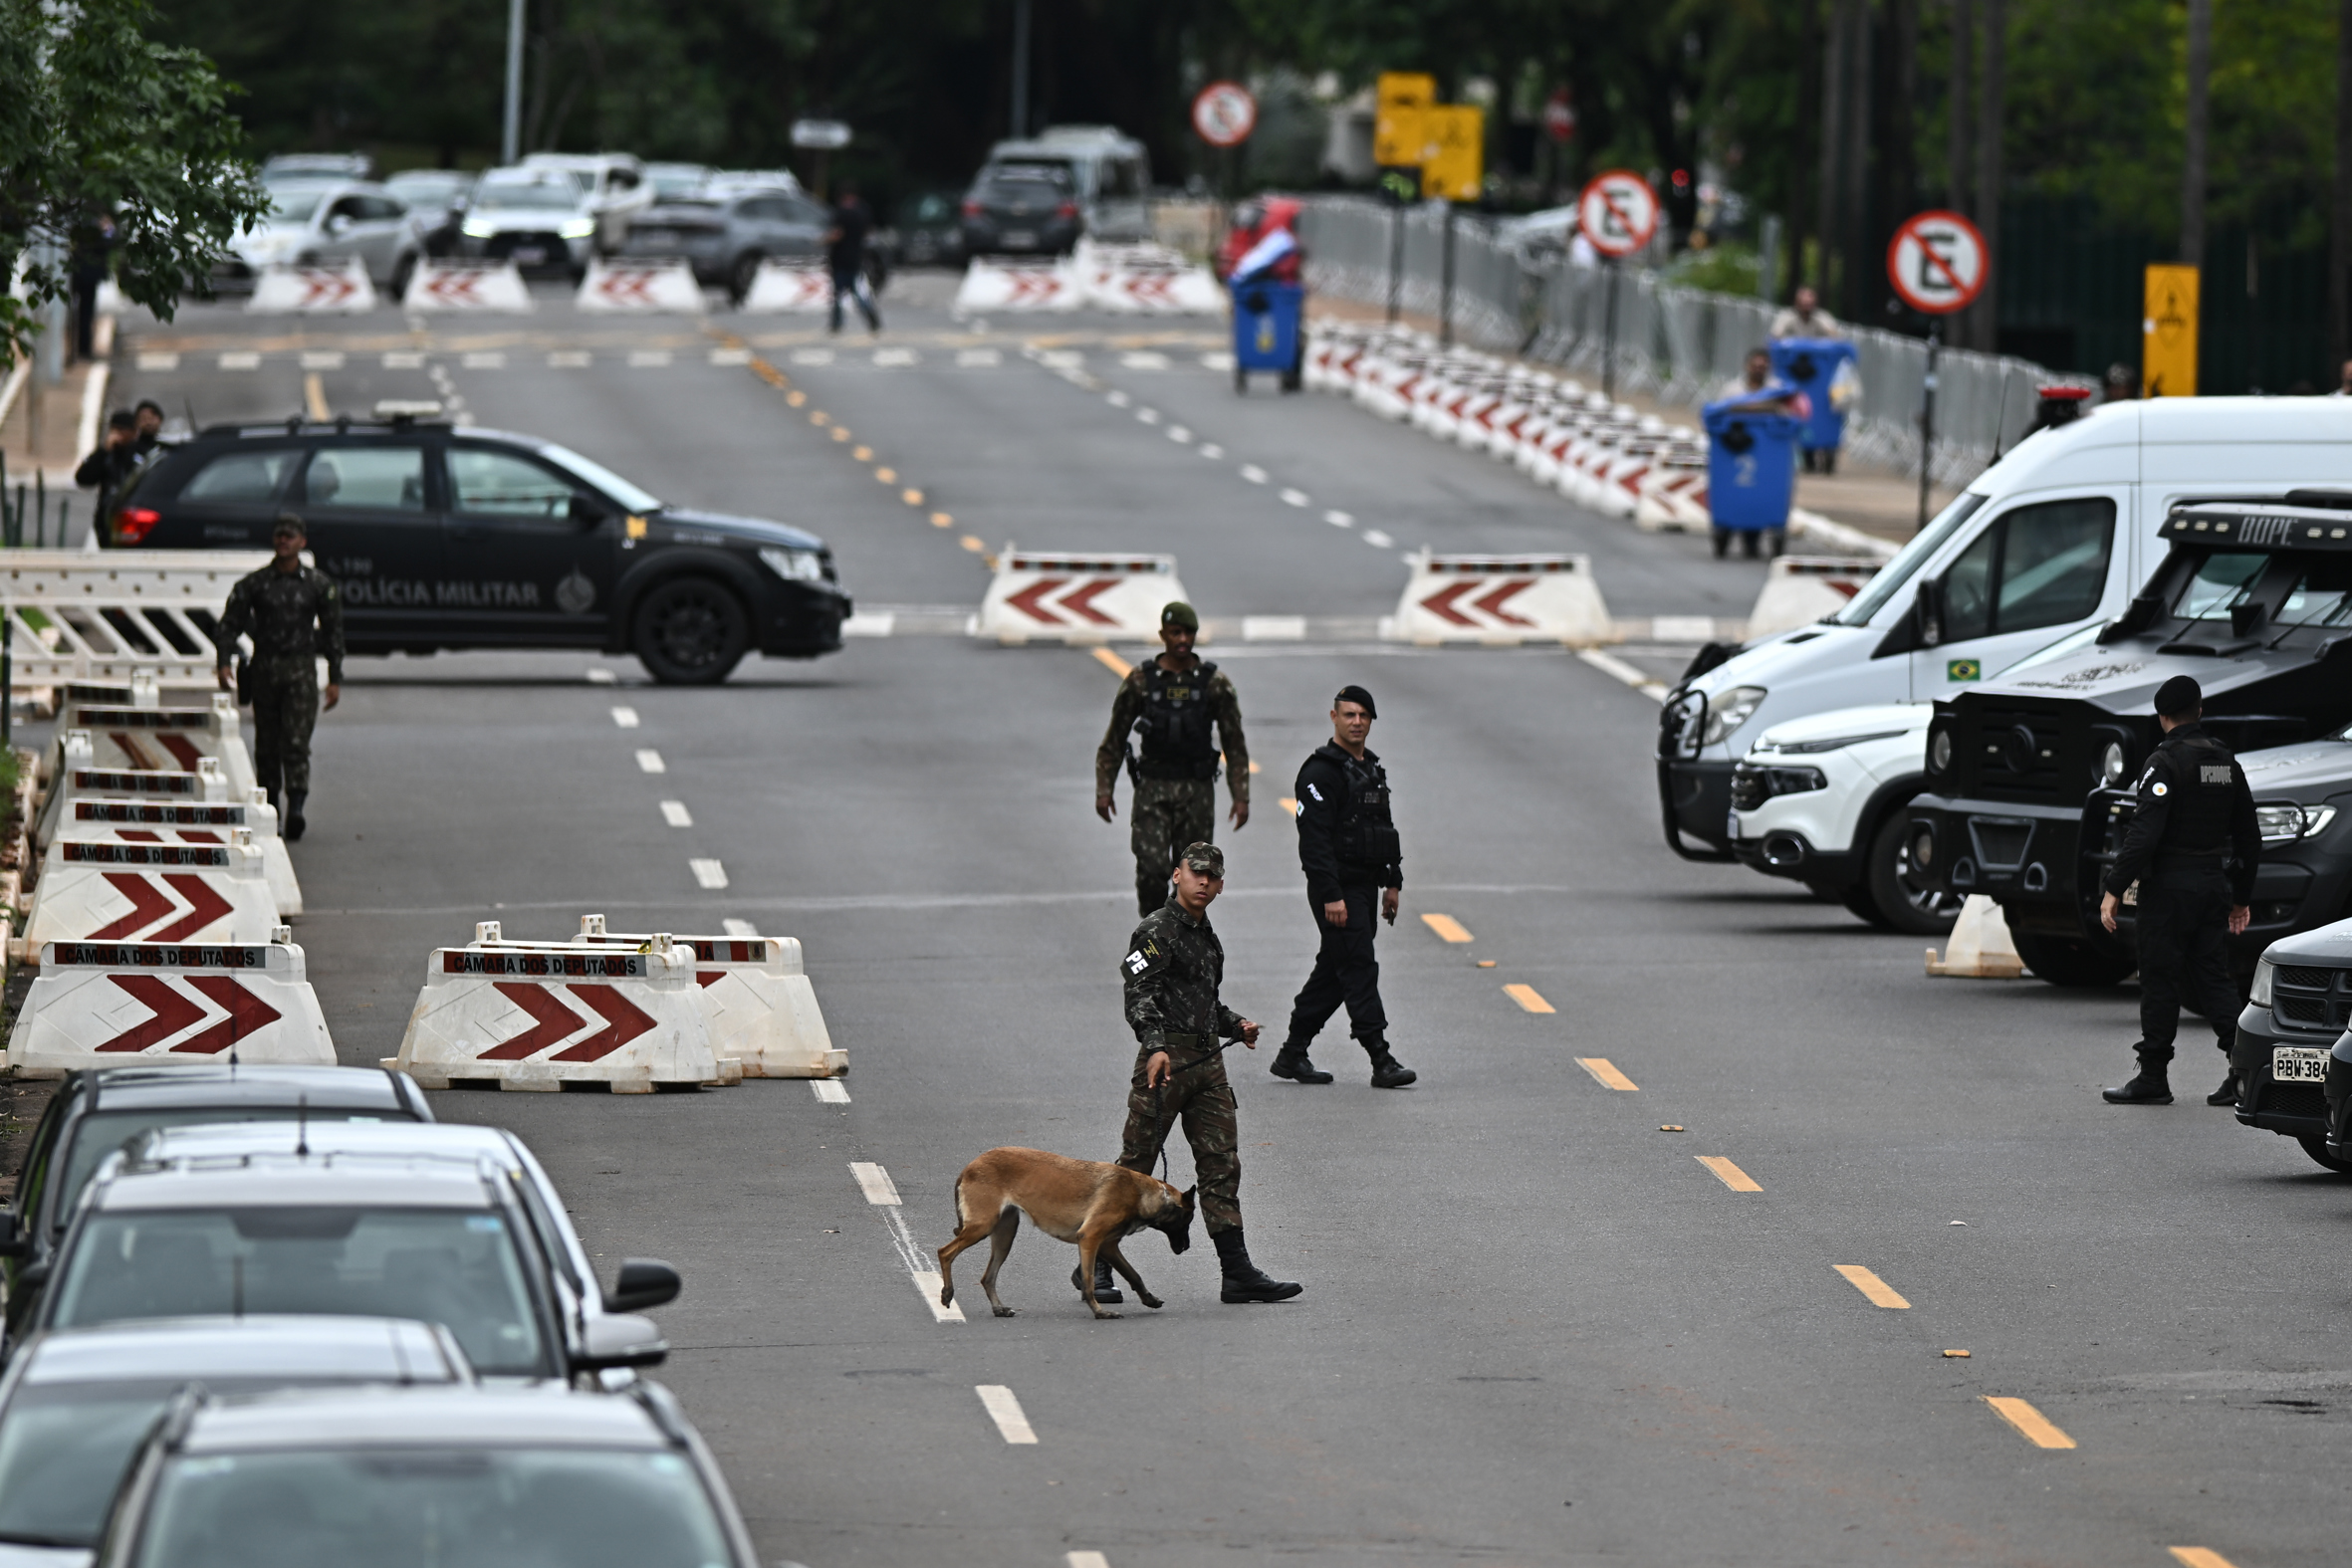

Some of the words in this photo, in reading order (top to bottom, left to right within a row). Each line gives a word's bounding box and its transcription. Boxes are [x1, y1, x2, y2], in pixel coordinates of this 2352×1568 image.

[2237, 516, 2298, 546] BOPE
[337, 576, 432, 604] OLÍCIA
[436, 581, 540, 605] MILITAR
[125, 848, 149, 863] DOS
[152, 849, 221, 864] DEPUTADOS
[65, 945, 128, 964] CÂMARA
[133, 949, 163, 965] DOS
[167, 950, 255, 966] DEPUTADOS
[454, 953, 516, 973] CÂMARA
[519, 958, 549, 973] DOS
[553, 959, 636, 975] DEPUTADOS
[1125, 950, 1149, 975] PE
